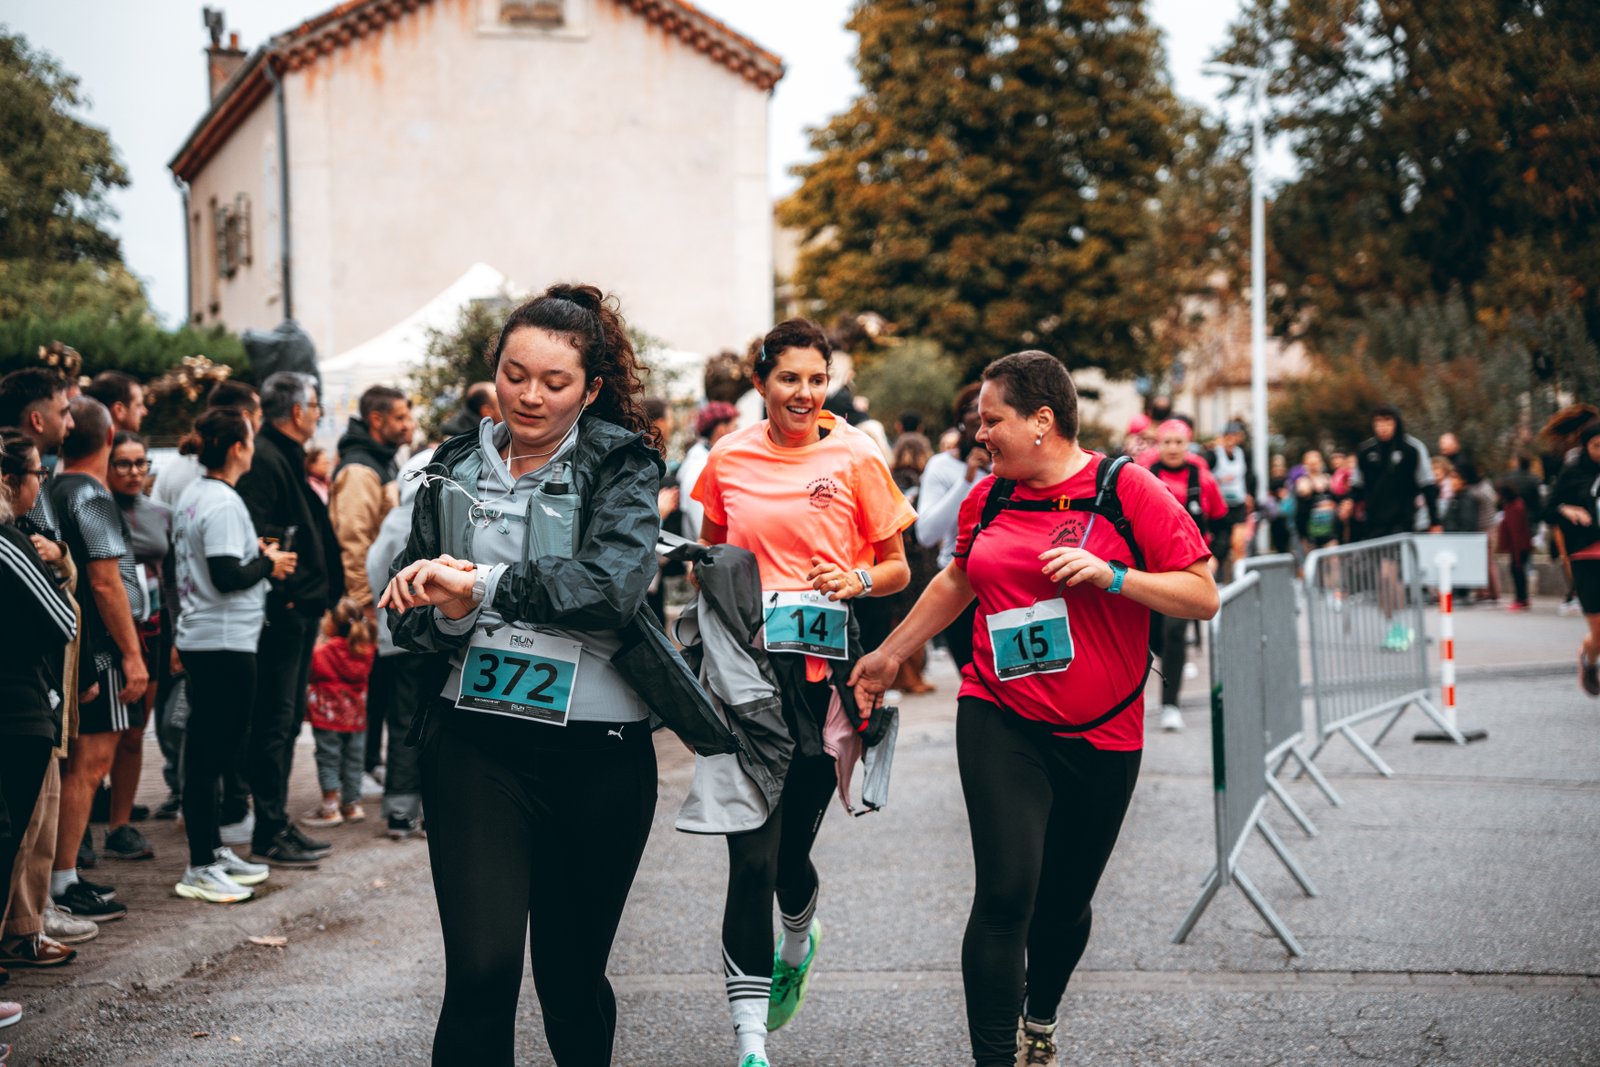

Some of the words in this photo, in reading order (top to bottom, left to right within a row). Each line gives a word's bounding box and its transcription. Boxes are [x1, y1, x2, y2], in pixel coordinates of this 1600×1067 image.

[510, 635, 534, 645] RUN
[791, 608, 828, 642] 14
[1012, 625, 1049, 661] 15
[473, 653, 558, 704] 372
